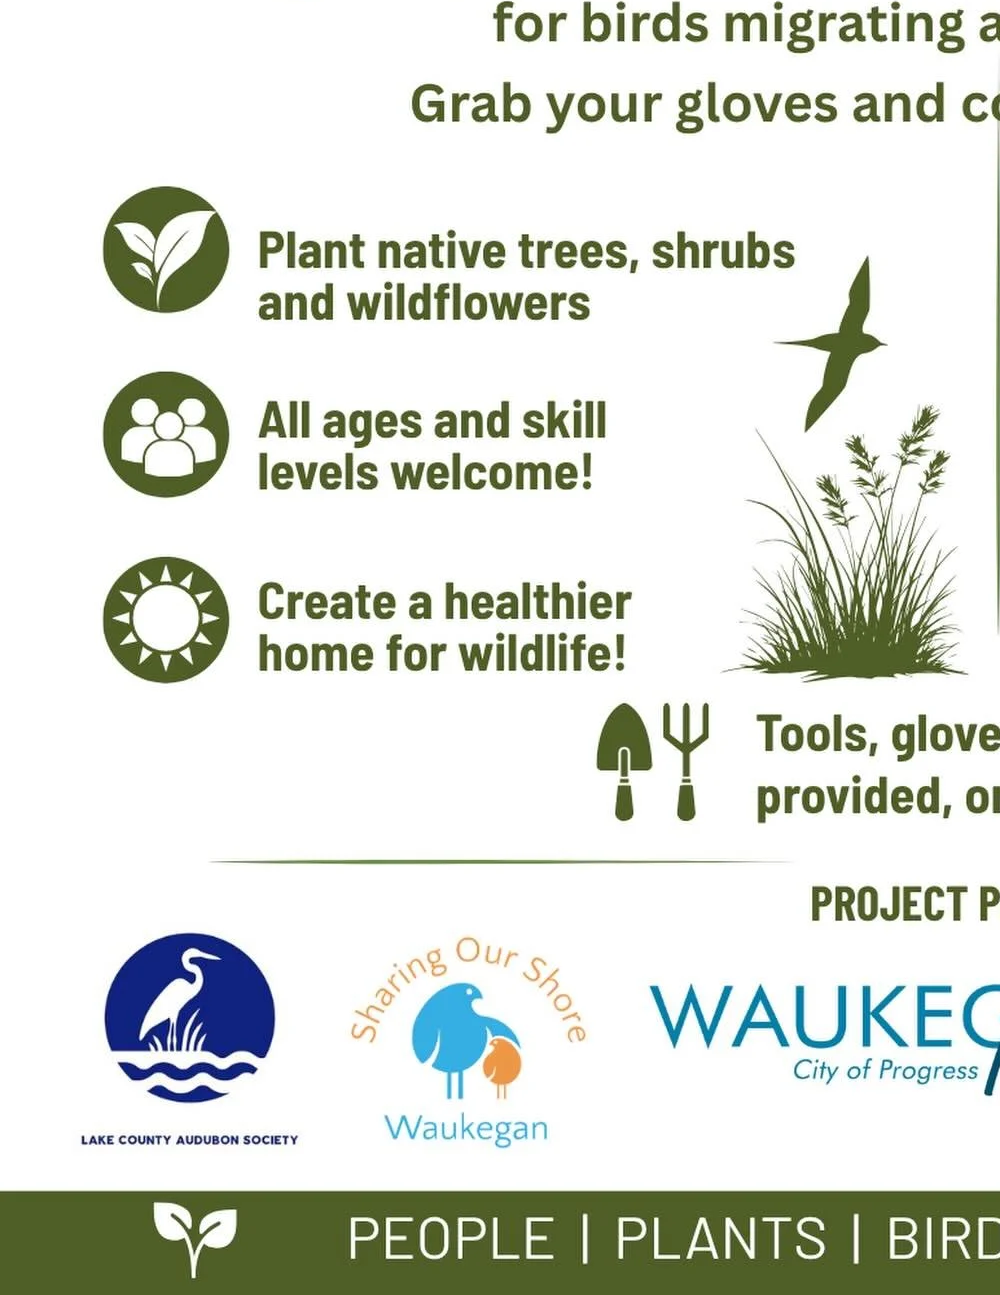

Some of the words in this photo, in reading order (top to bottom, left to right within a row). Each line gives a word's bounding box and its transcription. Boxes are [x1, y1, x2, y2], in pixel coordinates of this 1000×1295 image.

[493, 1, 567, 42] for
[583, 1, 708, 42] birds
[725, 1, 965, 54] migrating
[412, 82, 531, 123] Grab
[546, 93, 662, 134] your
[676, 82, 837, 134] gloves
[853, 82, 944, 122] and
[260, 231, 365, 268] Plant
[379, 230, 505, 269] native
[518, 234, 638, 273] trees,
[653, 231, 795, 269] shrubs
[258, 283, 333, 320] and
[347, 282, 590, 320] wildflowers
[259, 401, 310, 438] All
[323, 410, 422, 448] ages
[434, 401, 509, 438] and
[523, 399, 605, 438] skill
[259, 453, 378, 490] levels
[391, 453, 591, 490] welcome!
[259, 582, 396, 619] Create
[409, 592, 432, 619] a
[446, 580, 632, 619] healthier
[259, 634, 373, 671] home
[386, 634, 447, 671] for
[459, 632, 624, 671] wildlife!
[756, 714, 877, 756] Tools,
[758, 775, 951, 823] provided,
[812, 886, 968, 921] PROJECT
[351, 948, 448, 1043] Sharing
[456, 937, 519, 968] Our
[522, 957, 587, 1043] Shore
[793, 1059, 839, 1085] City
[847, 1059, 872, 1081] of
[880, 1059, 979, 1086] Progress
[81, 1134, 115, 1146] LAKE
[118, 1134, 172, 1146] COUNTY
[175, 1134, 240, 1146] AUDUBON
[242, 1134, 299, 1146] SOCIETY
[385, 1113, 547, 1148] Waukegan
[351, 1217, 554, 1259] PEOPLE
[618, 1217, 825, 1259] PLANTS
